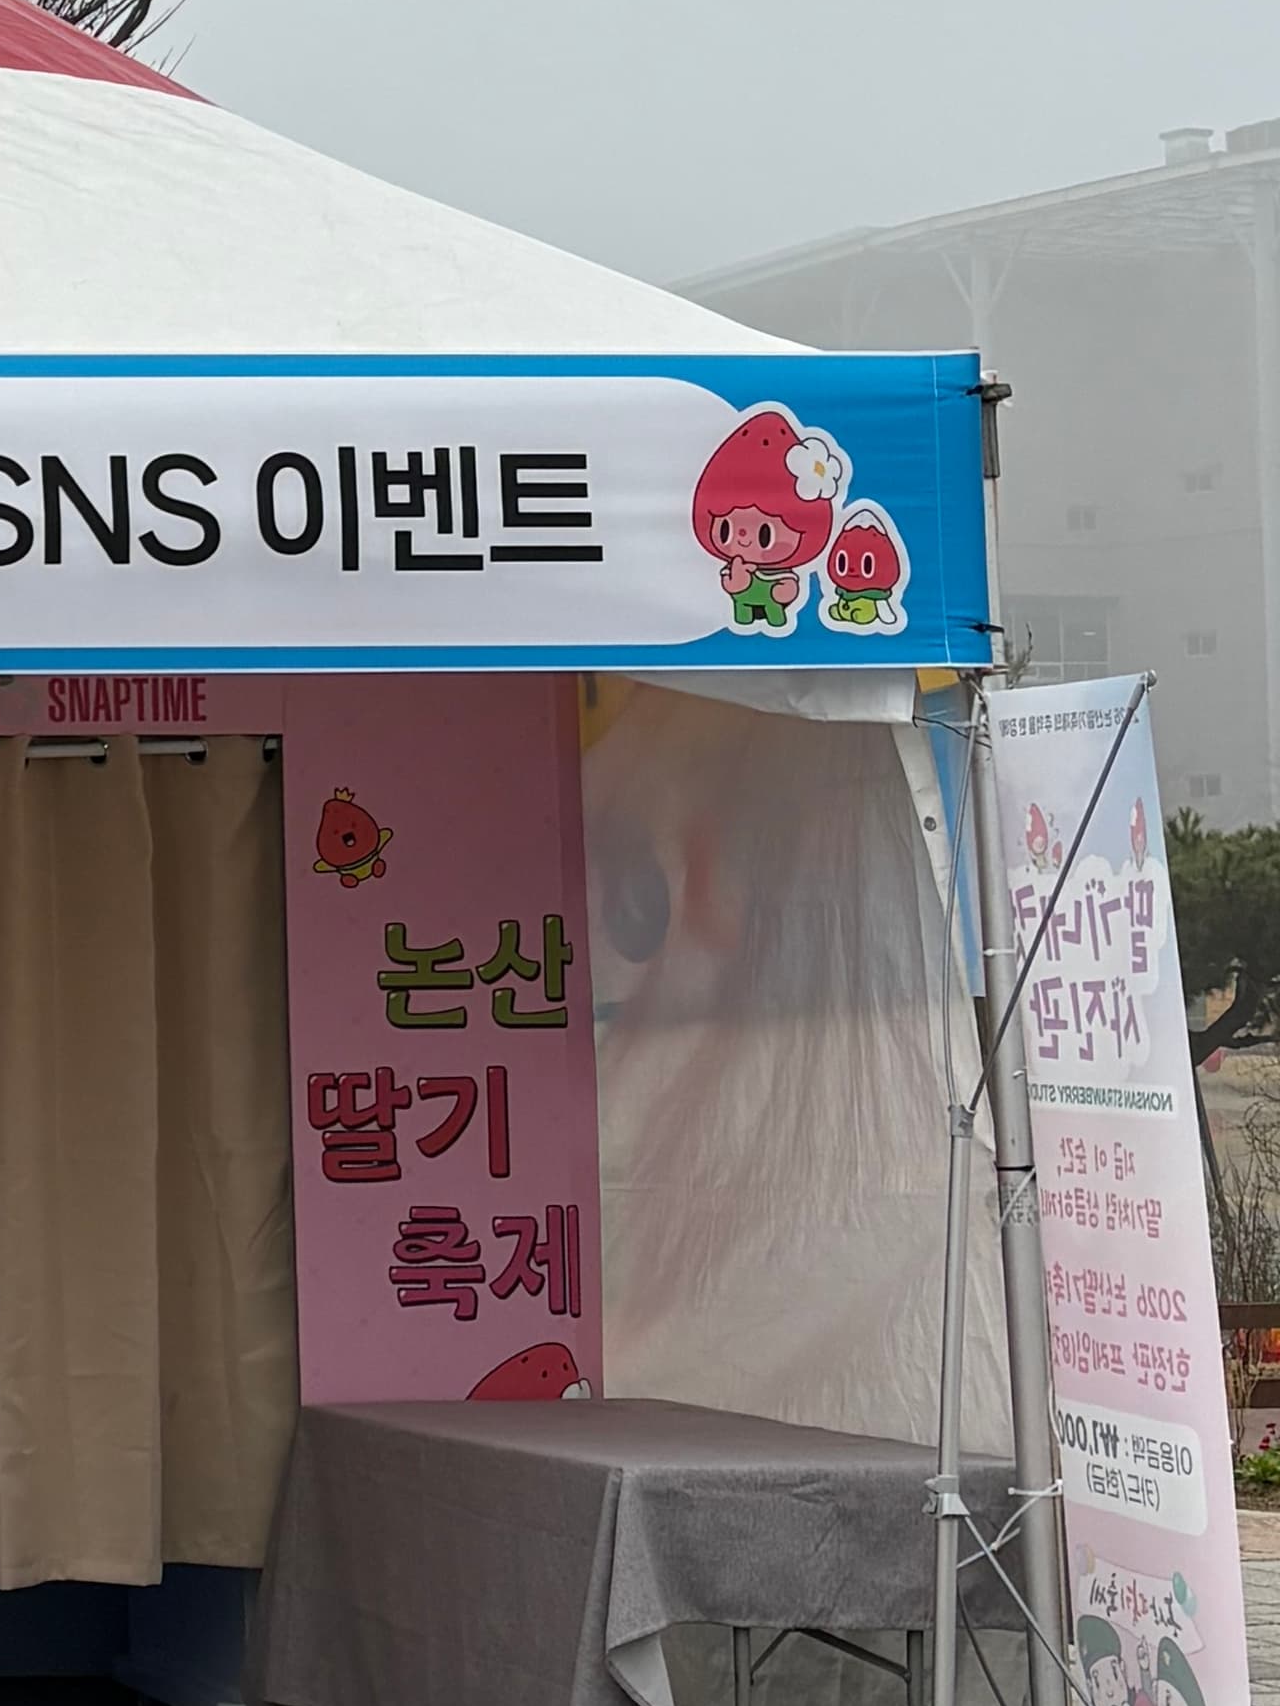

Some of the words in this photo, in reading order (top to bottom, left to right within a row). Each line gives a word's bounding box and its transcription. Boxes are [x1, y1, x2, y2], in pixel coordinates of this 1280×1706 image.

[257, 446, 604, 572] 이벤트
[48, 677, 207, 723] SNAPTIME
[377, 914, 573, 1030] 논산
[307, 1065, 511, 1183] 딸기
[388, 1205, 582, 1322] 축제
